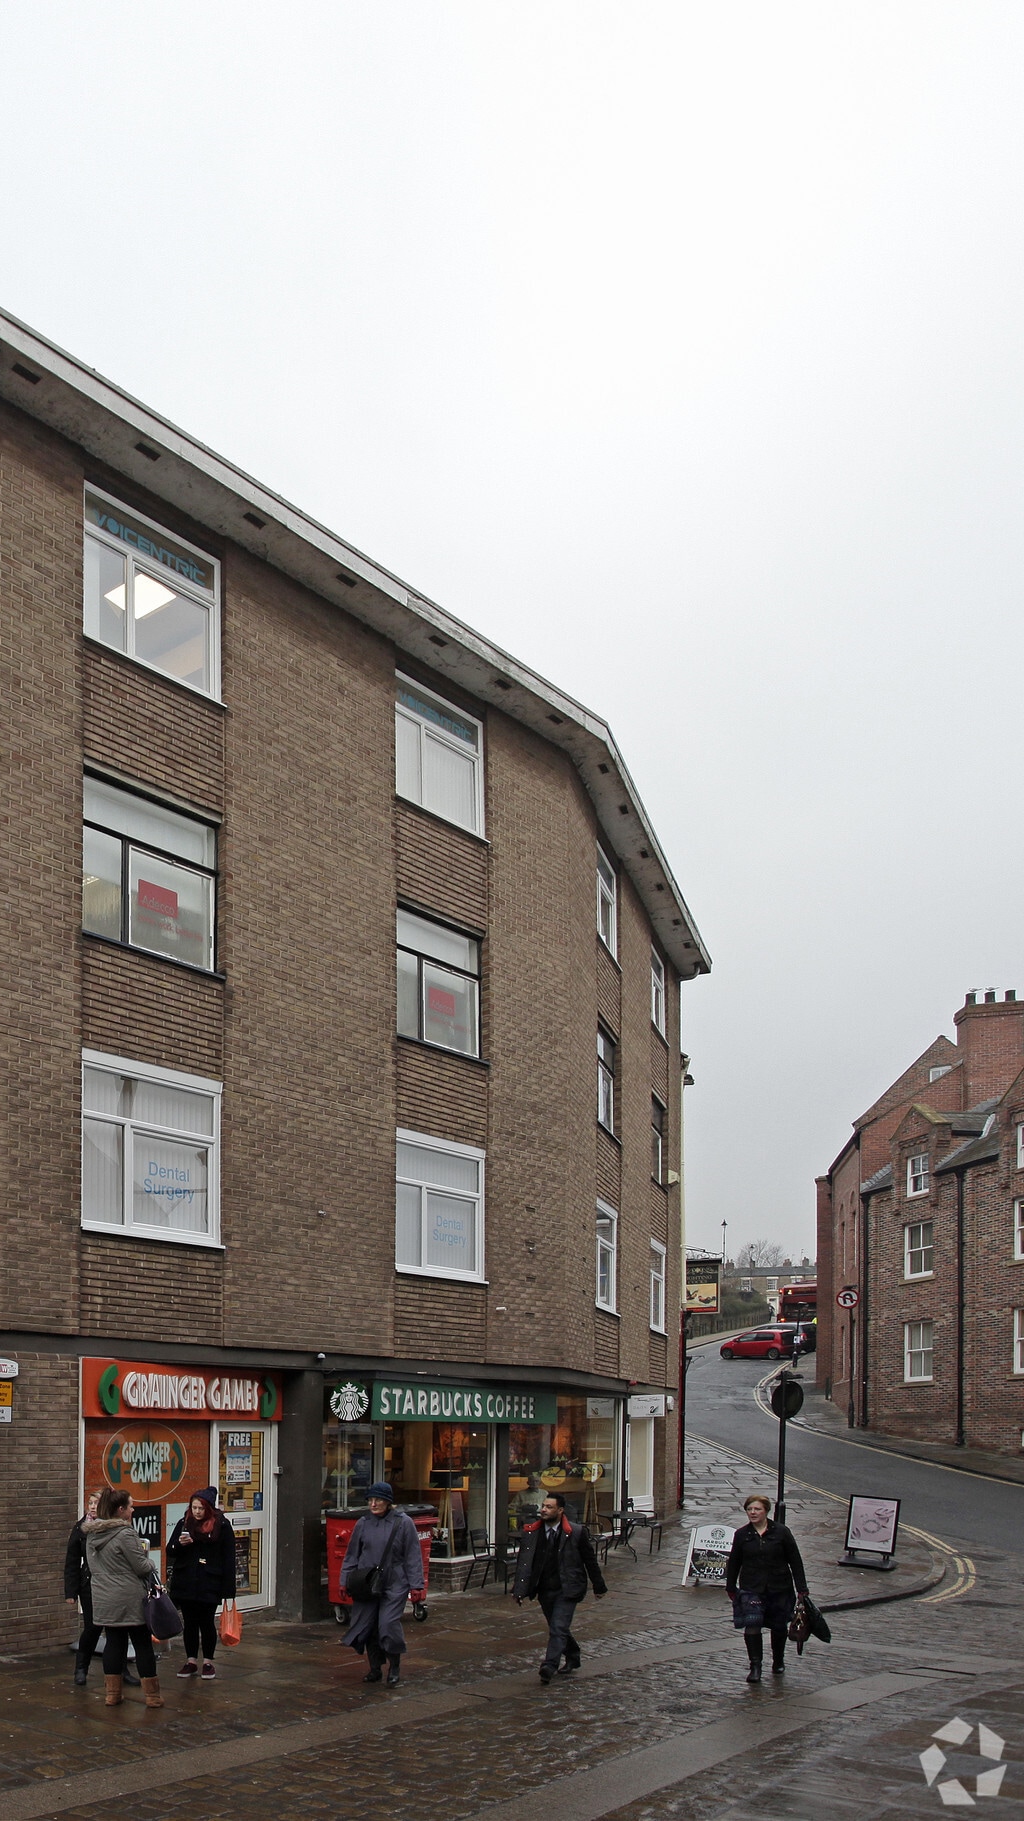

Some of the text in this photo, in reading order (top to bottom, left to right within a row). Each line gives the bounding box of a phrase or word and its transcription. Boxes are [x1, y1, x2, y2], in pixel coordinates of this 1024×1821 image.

[93, 508, 206, 587] VOICENTRIC
[142, 896, 175, 914] Adecco
[149, 1161, 190, 1182] Dental
[144, 1178, 194, 1203] Surgery
[436, 1215, 464, 1231] Dental
[433, 1229, 467, 1248] Surgery
[122, 1371, 259, 1411] GRAINGER GAMES
[379, 1387, 535, 1419] STARBUCKS COFFEE
[228, 1432, 251, 1447] FREE
[121, 1441, 171, 1463] GRAINGER
[130, 1462, 162, 1483] GAMES
[132, 1515, 157, 1535] Wii
